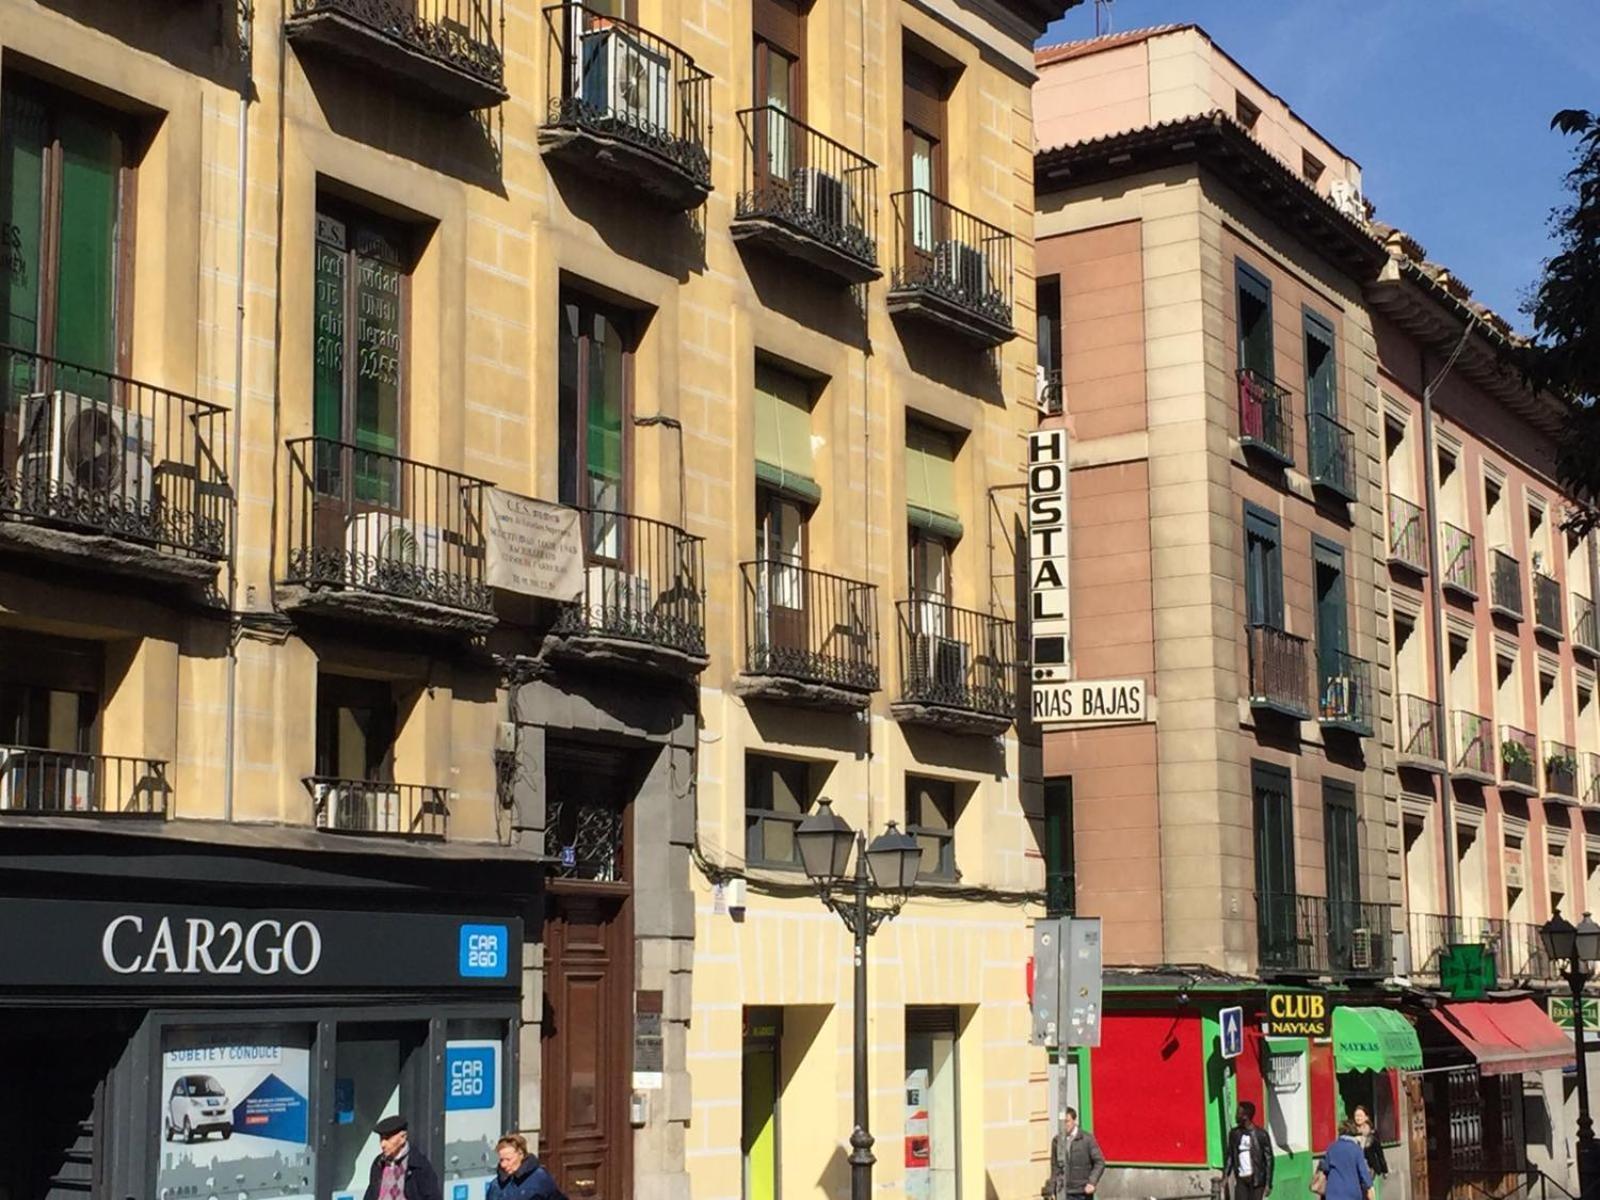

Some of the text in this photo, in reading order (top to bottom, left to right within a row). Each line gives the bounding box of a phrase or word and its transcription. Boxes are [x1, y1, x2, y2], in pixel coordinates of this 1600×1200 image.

[1030, 433, 1063, 619] HOSTAL
[1033, 686, 1140, 718] RIAS BAJAS
[102, 915, 322, 975] CAR2GO
[468, 934, 498, 950] CAR
[468, 951, 498, 967] 2GO
[1270, 994, 1325, 1018] CLUB
[1272, 1022, 1325, 1034] NAYKAS
[451, 1060, 483, 1077] CAR
[451, 1078, 483, 1096] 2GO
